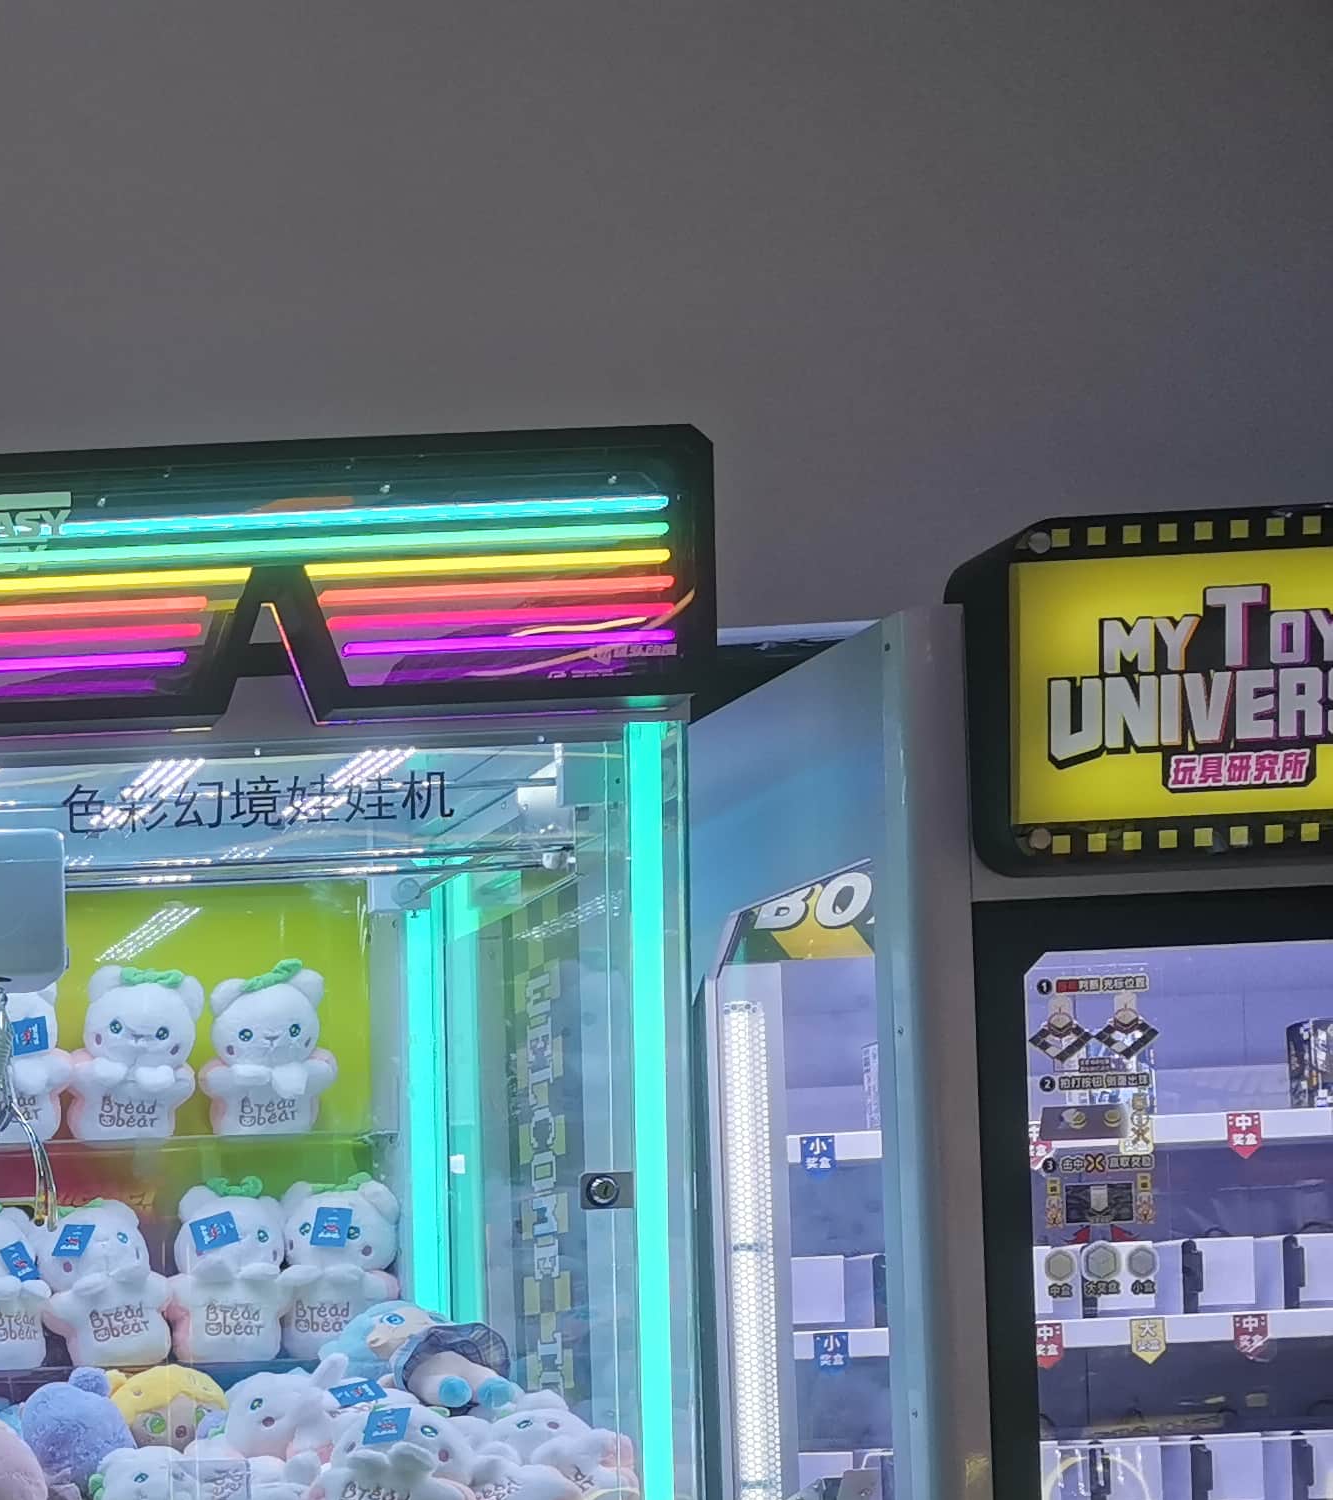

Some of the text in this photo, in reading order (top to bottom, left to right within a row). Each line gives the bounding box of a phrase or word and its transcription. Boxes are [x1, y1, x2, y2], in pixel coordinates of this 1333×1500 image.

[1103, 615, 1201, 673] MY
[1050, 666, 1333, 761] UNIVER
[1170, 750, 1309, 787] 玩具研究所
[62, 770, 455, 834] 色彩幻境娃娃机
[755, 871, 874, 931] BO
[1235, 1114, 1252, 1131] 中
[809, 1137, 828, 1155] 小
[1037, 1325, 1054, 1342] 中
[1140, 1321, 1157, 1337] 大
[1242, 1315, 1259, 1332] 中
